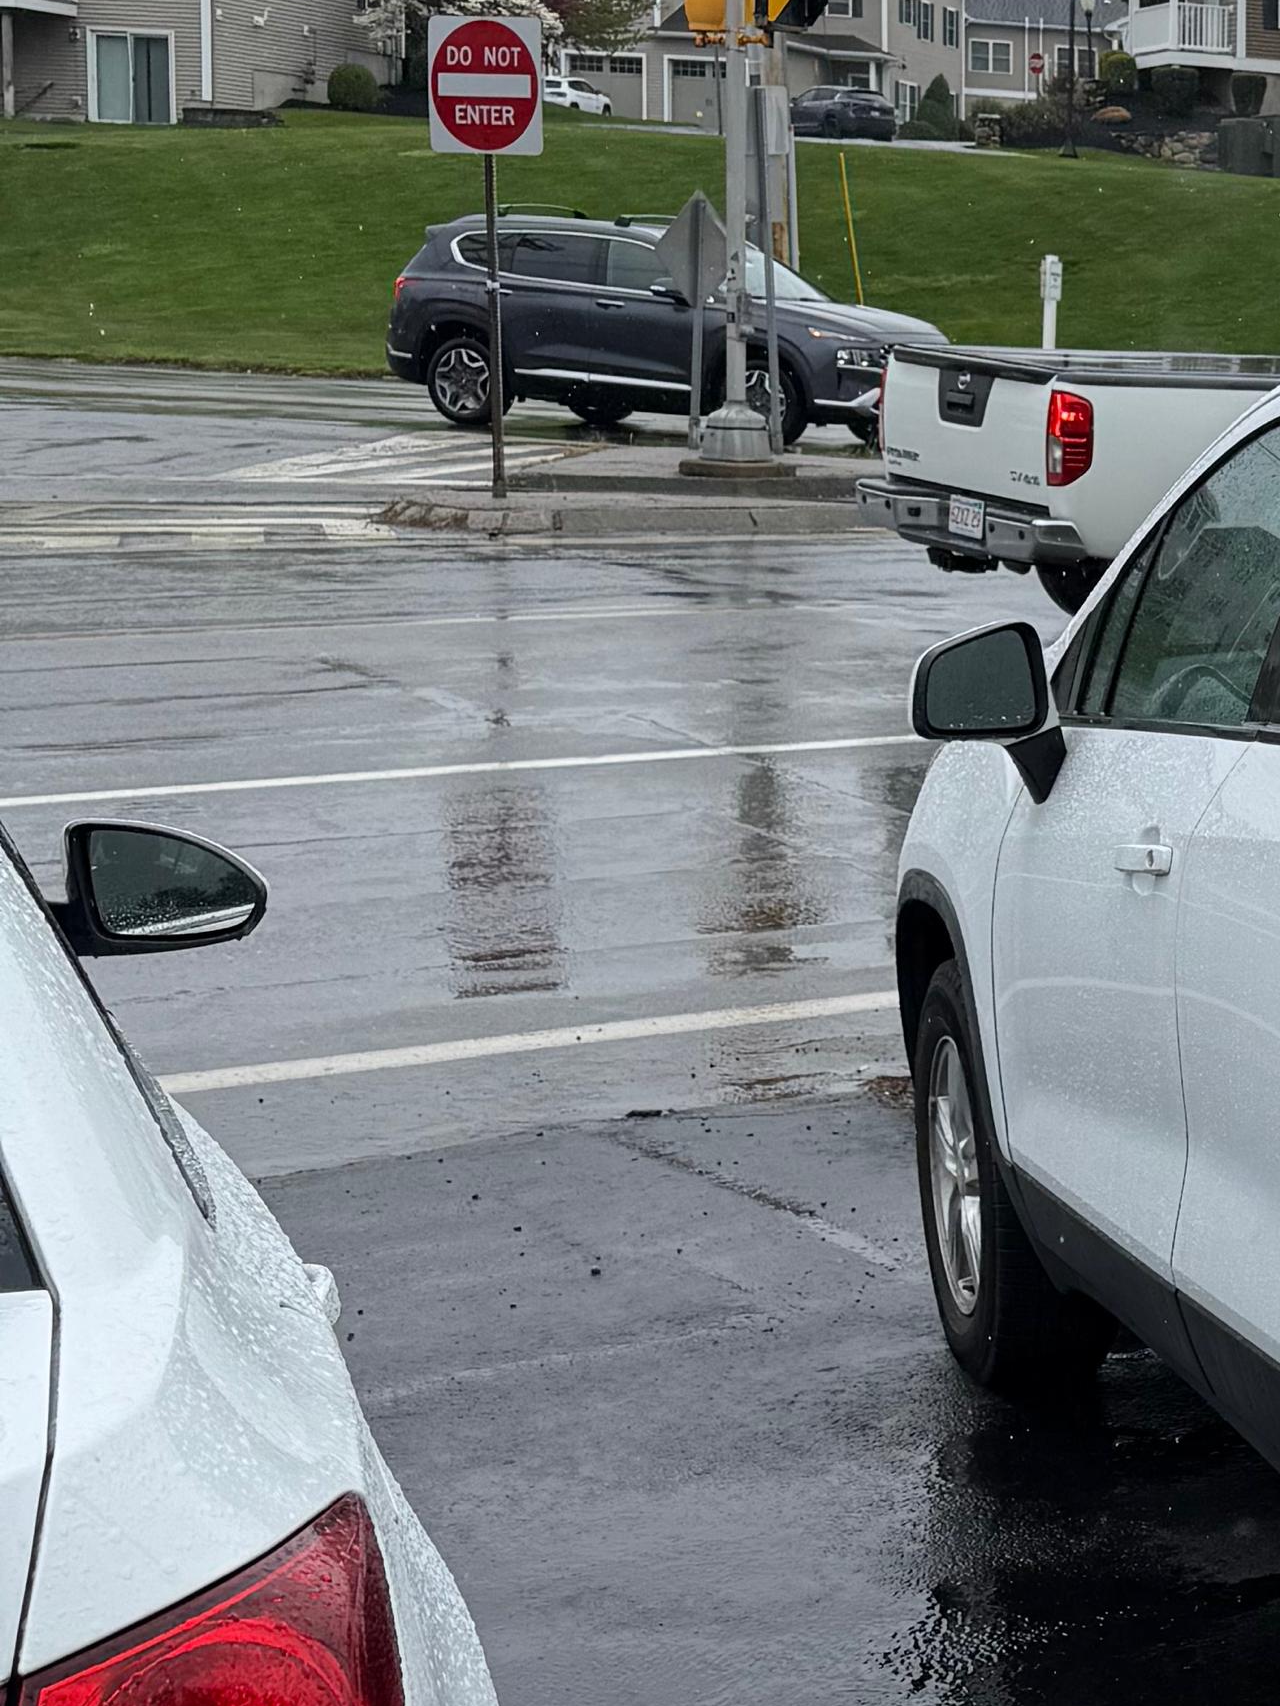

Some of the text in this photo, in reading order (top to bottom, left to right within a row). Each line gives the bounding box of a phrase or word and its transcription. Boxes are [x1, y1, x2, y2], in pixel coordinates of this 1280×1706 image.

[447, 46, 521, 67] DO NOT
[455, 105, 515, 126] ENTER
